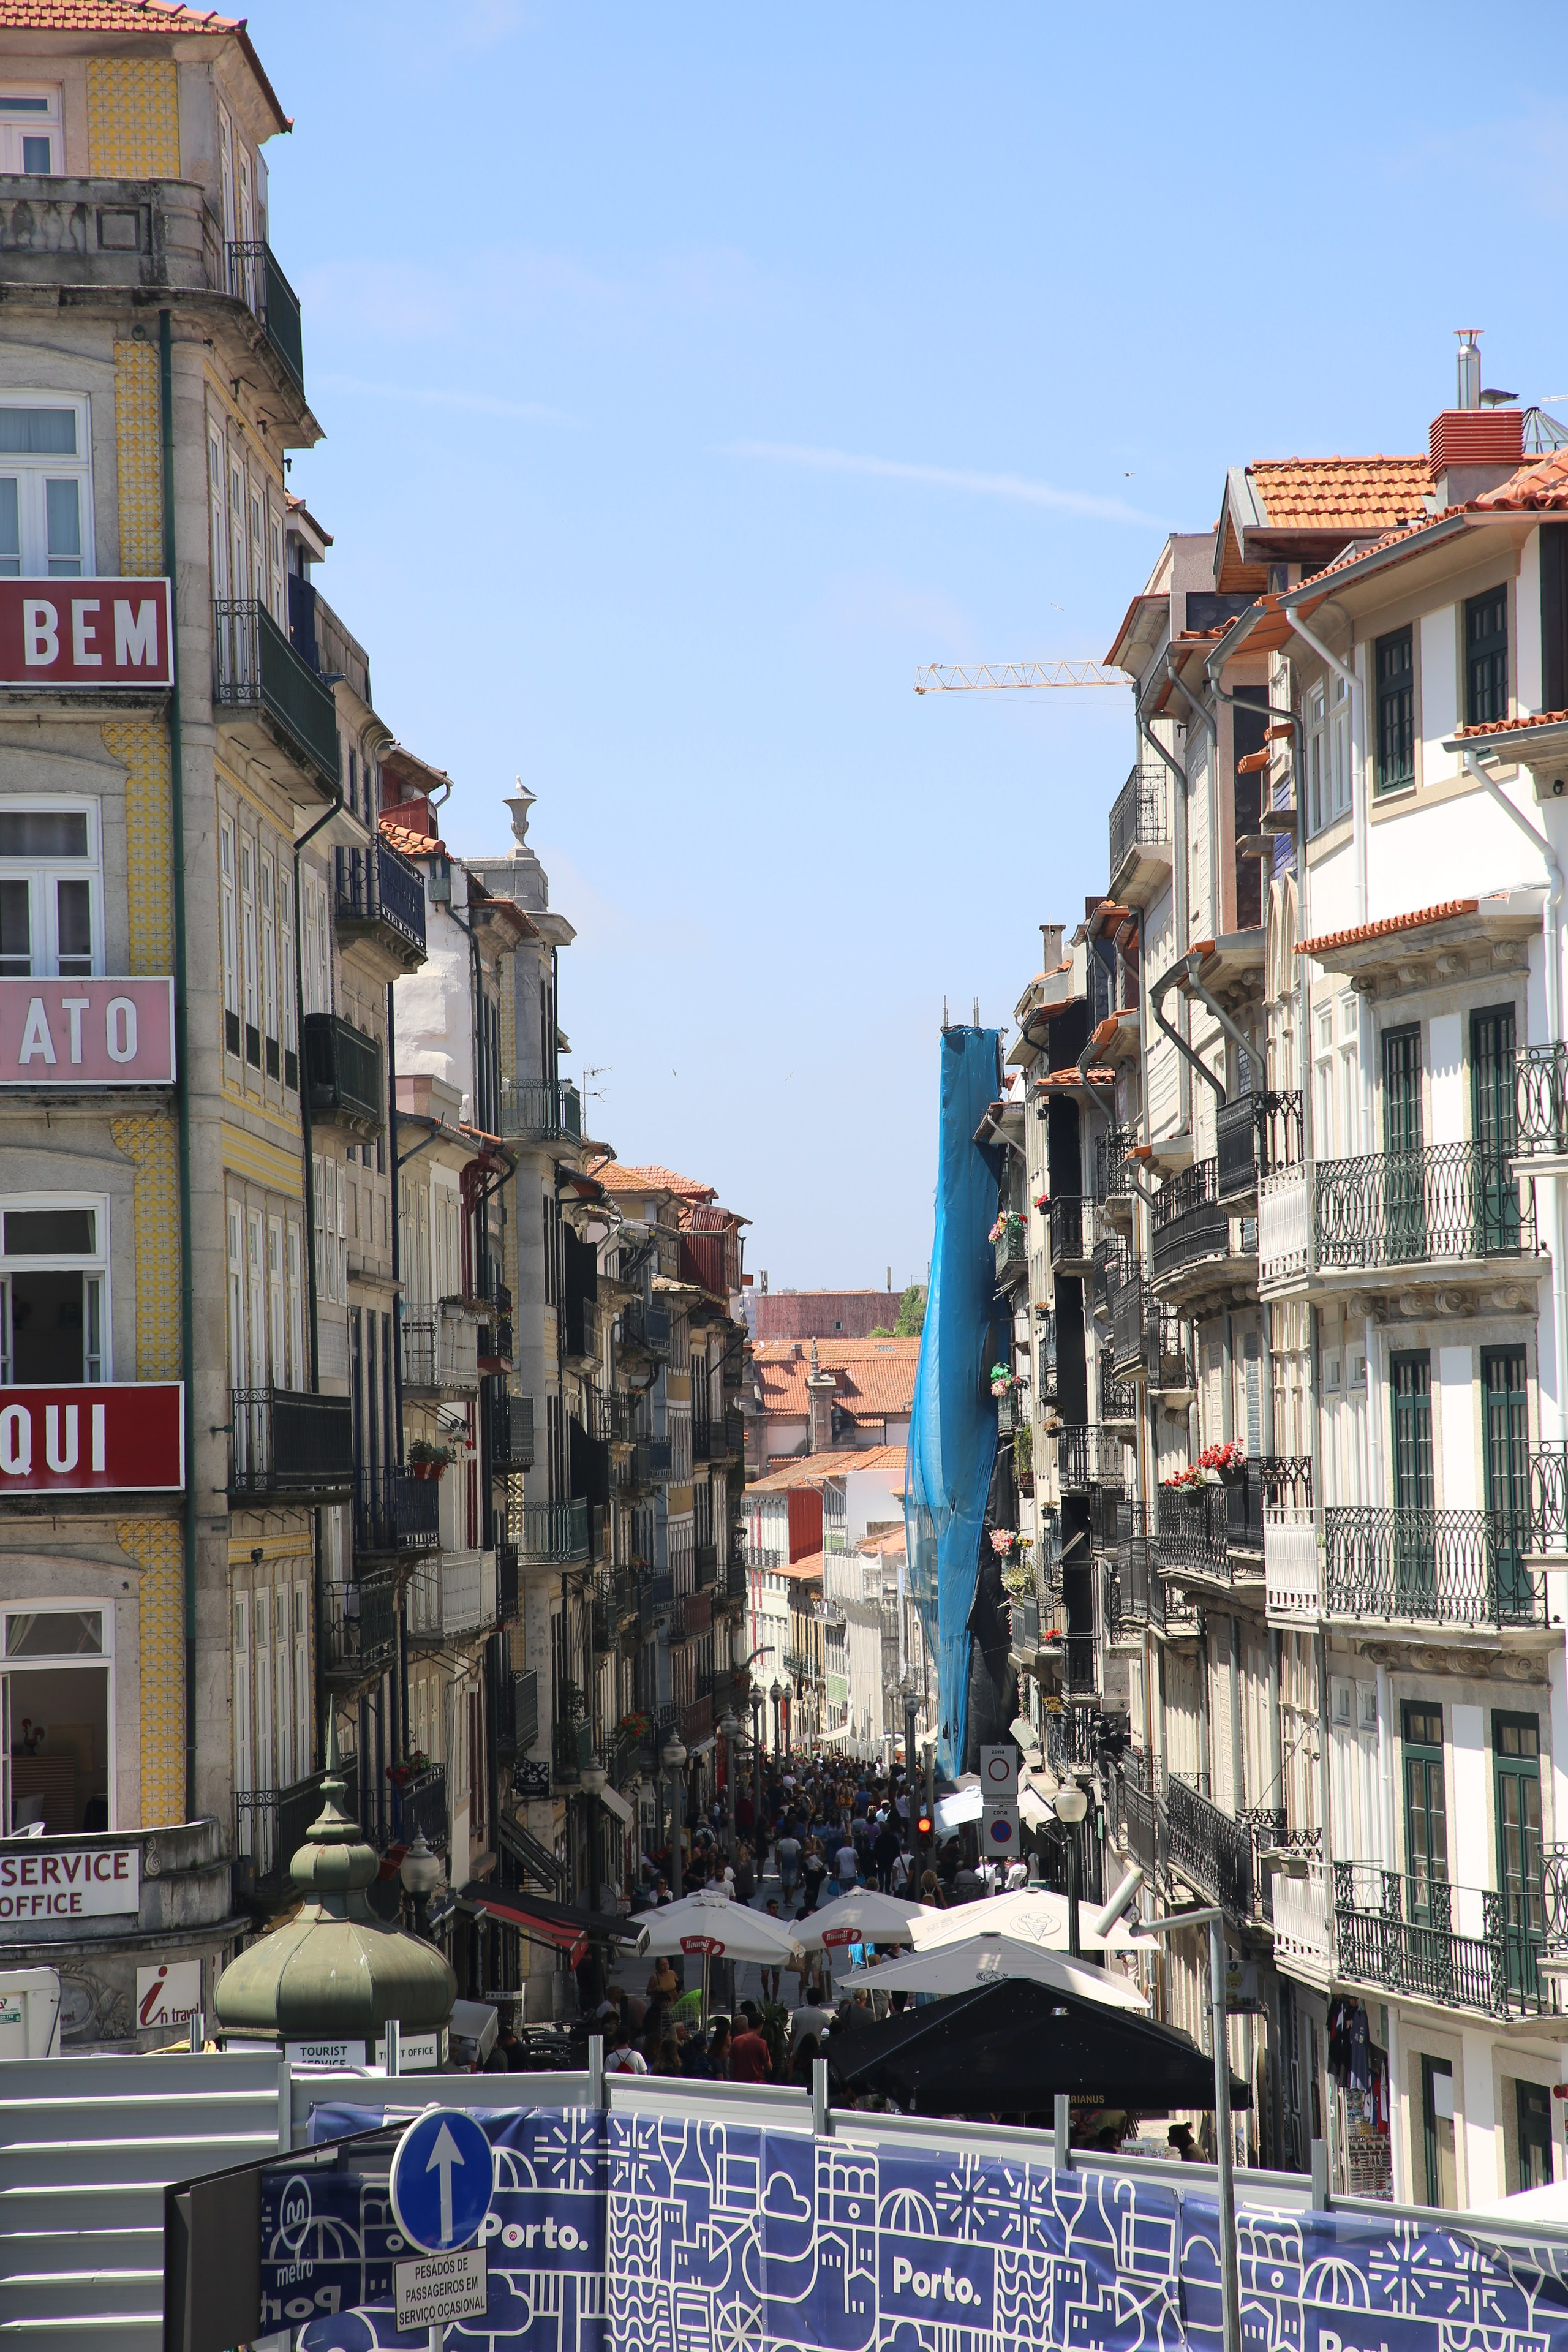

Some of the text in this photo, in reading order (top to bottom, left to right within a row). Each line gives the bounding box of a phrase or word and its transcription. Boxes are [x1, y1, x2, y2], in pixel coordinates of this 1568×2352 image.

[23, 599, 158, 666] BEM
[18, 997, 138, 1065] ATO
[0, 1404, 105, 1476] QUI
[1, 1852, 129, 1887] SERVICE
[0, 1893, 83, 1917] OFFICE
[300, 2046, 347, 2057] TOURIST
[379, 2046, 434, 2060] TIT OFFICE
[1069, 2095, 1106, 2105] RIANUS
[478, 2212, 589, 2251] Porto.
[277, 2258, 314, 2288] metro
[415, 2257, 468, 2280] PESADOS DE
[894, 2256, 982, 2306] Porto.
[405, 2276, 478, 2303] PASSAGEIROS EM
[399, 2296, 485, 2326] SERVIÇO OCASIONAL
